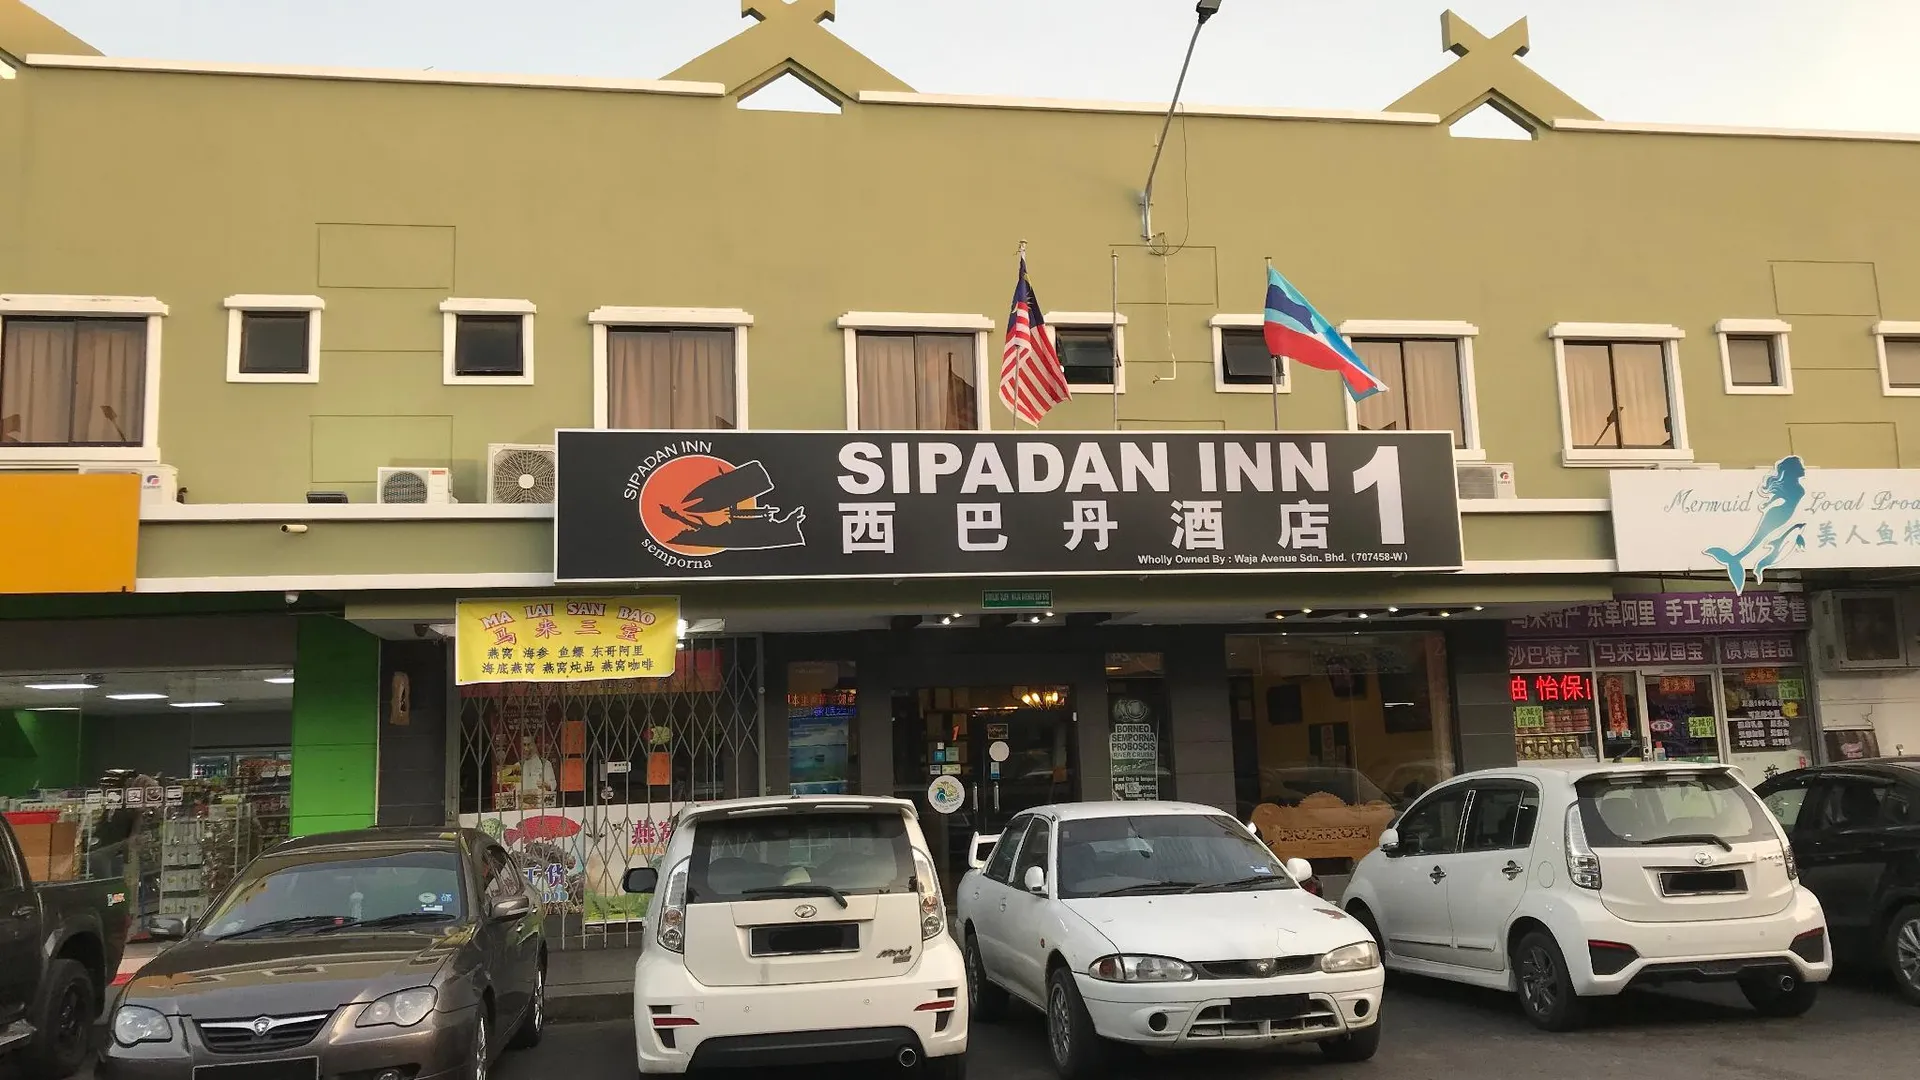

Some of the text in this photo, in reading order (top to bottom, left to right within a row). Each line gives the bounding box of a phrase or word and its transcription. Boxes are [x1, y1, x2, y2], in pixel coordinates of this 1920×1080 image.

[624, 440, 713, 500] SIPADAN INN
[837, 441, 1406, 546] SIPADAN INN 1
[1663, 488, 1754, 514] Mermaid
[1804, 491, 1866, 514] Local
[838, 499, 1330, 554] 西巴丹酒店
[641, 538, 714, 569] semporna
[1138, 554, 1173, 566] Wholly
[1175, 554, 1210, 564] Owned
[1212, 554, 1226, 565] By
[1234, 554, 1259, 565] Waja
[1260, 553, 1298, 563] Avenue
[1300, 553, 1322, 563] Sdn.
[1325, 552, 1347, 563] Bhd.
[1351, 552, 1408, 563] (707458-W)
[480, 602, 657, 631] MA LAI SAN BAO
[1665, 597, 1735, 625] 手工燕窝
[1739, 596, 1808, 624] 批发零售
[492, 619, 644, 646] 马来三宝
[487, 648, 514, 659] 燕窝
[523, 647, 550, 659] 海参
[592, 645, 645, 658] 东哥阿里
[1508, 640, 1793, 666] 沙巴特产 马来西亚国宝 馈赠佳品
[481, 658, 655, 674] 海底燕窝 燕窝炖品 燕窝咖啡
[1536, 674, 1592, 701] 怡保
[1111, 734, 1156, 742] SEMPORNA
[1117, 725, 1150, 733] BORNEO
[1112, 743, 1156, 751] PROBOSCIS
